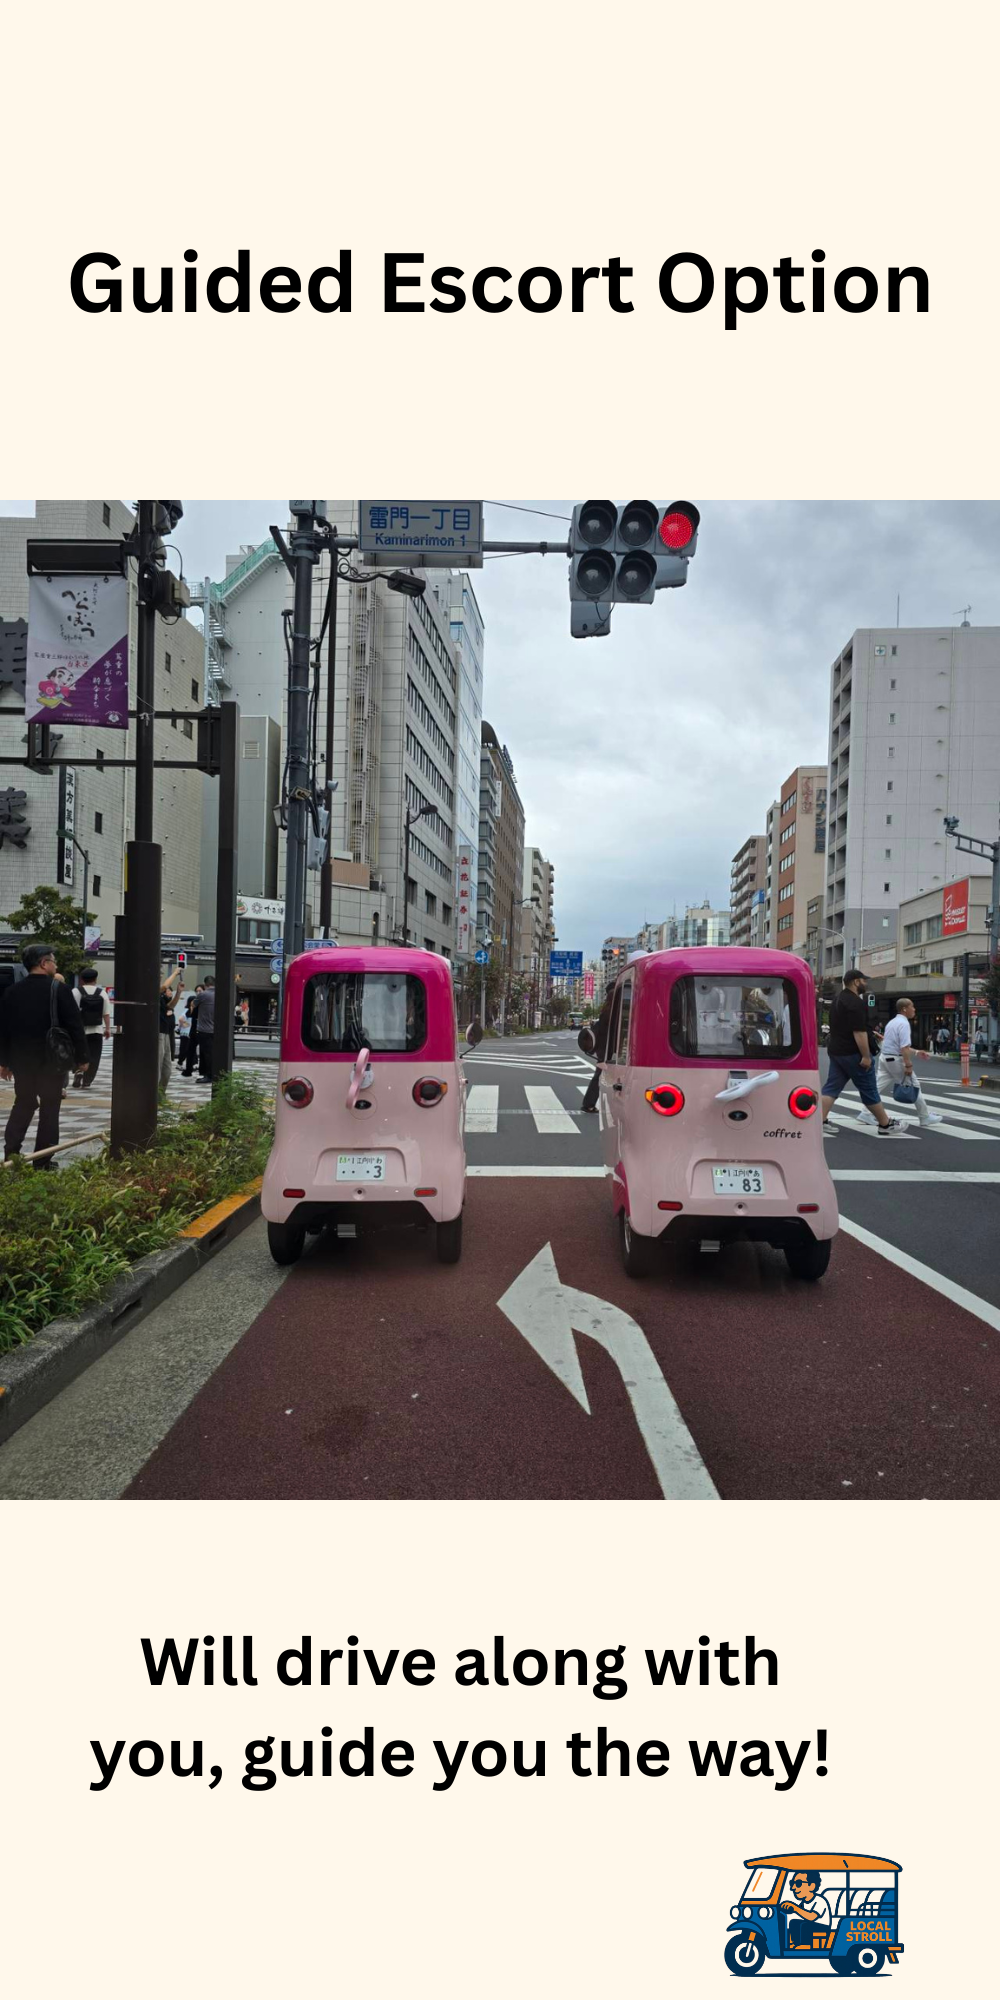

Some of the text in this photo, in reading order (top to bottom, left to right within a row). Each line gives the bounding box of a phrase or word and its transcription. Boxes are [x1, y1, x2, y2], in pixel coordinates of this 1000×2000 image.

[369, 506, 470, 531] 雷門一丁目
[375, 532, 466, 547] Kaminarimon 1
[61, 590, 95, 638] べらぼう
[763, 1128, 802, 1139] coffret
[753, 1169, 760, 1177] あ
